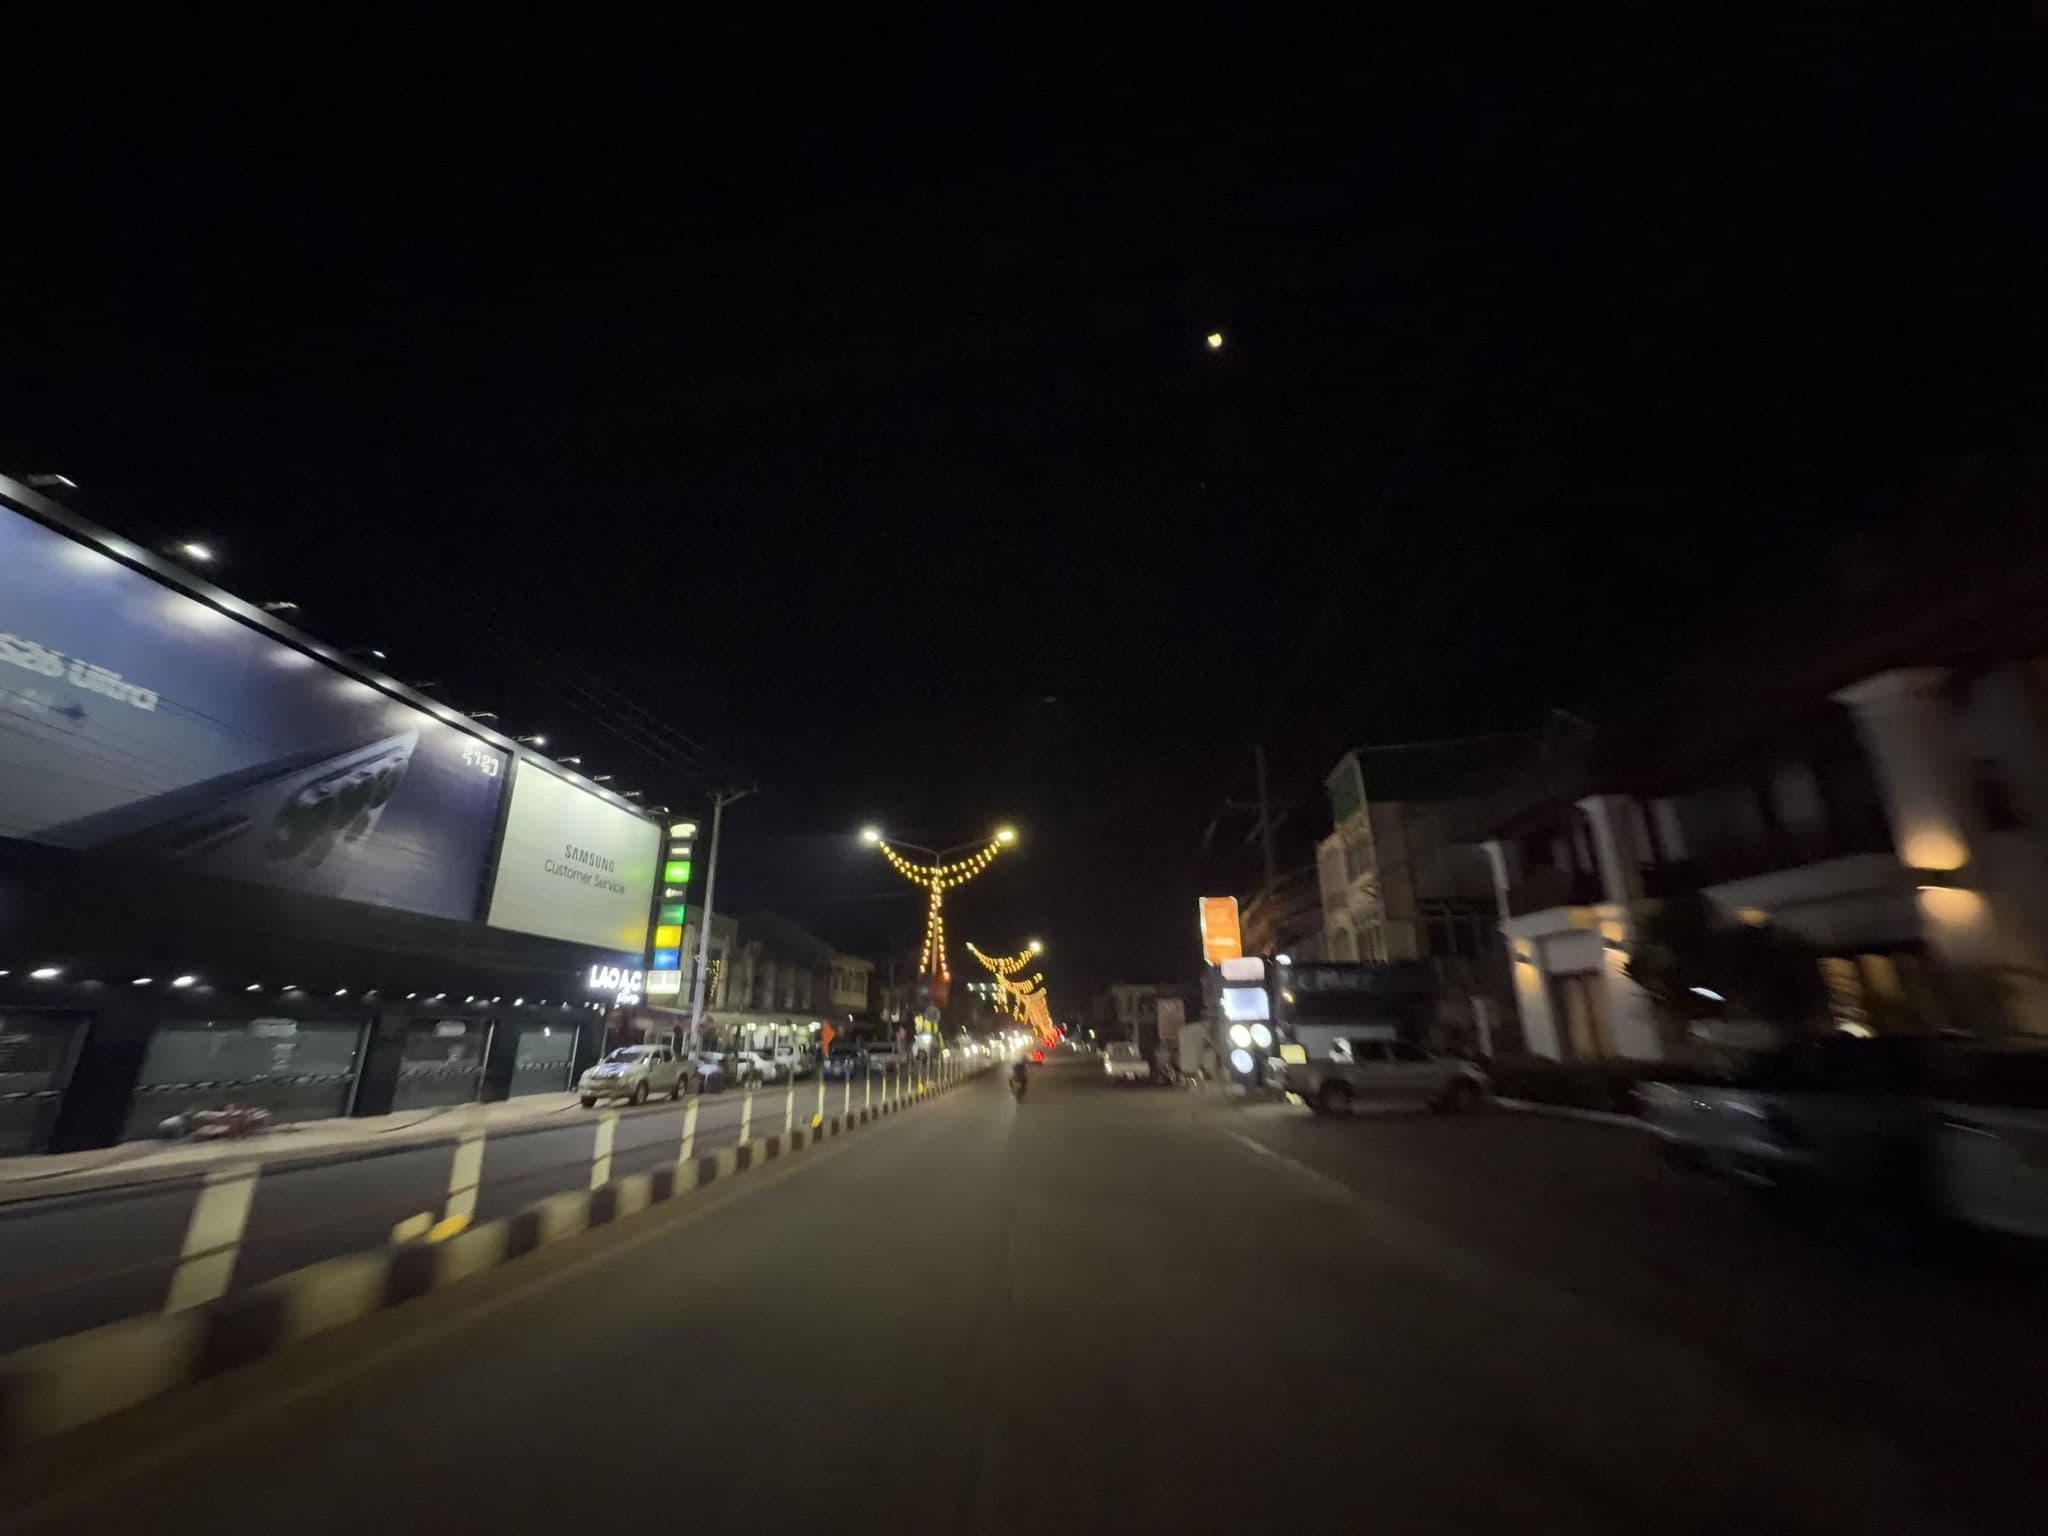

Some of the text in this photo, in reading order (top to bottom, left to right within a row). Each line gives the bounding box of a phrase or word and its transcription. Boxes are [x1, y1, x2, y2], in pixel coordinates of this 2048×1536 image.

[564, 844, 615, 873] SAMSUNG
[544, 858, 625, 895] Customer Service
